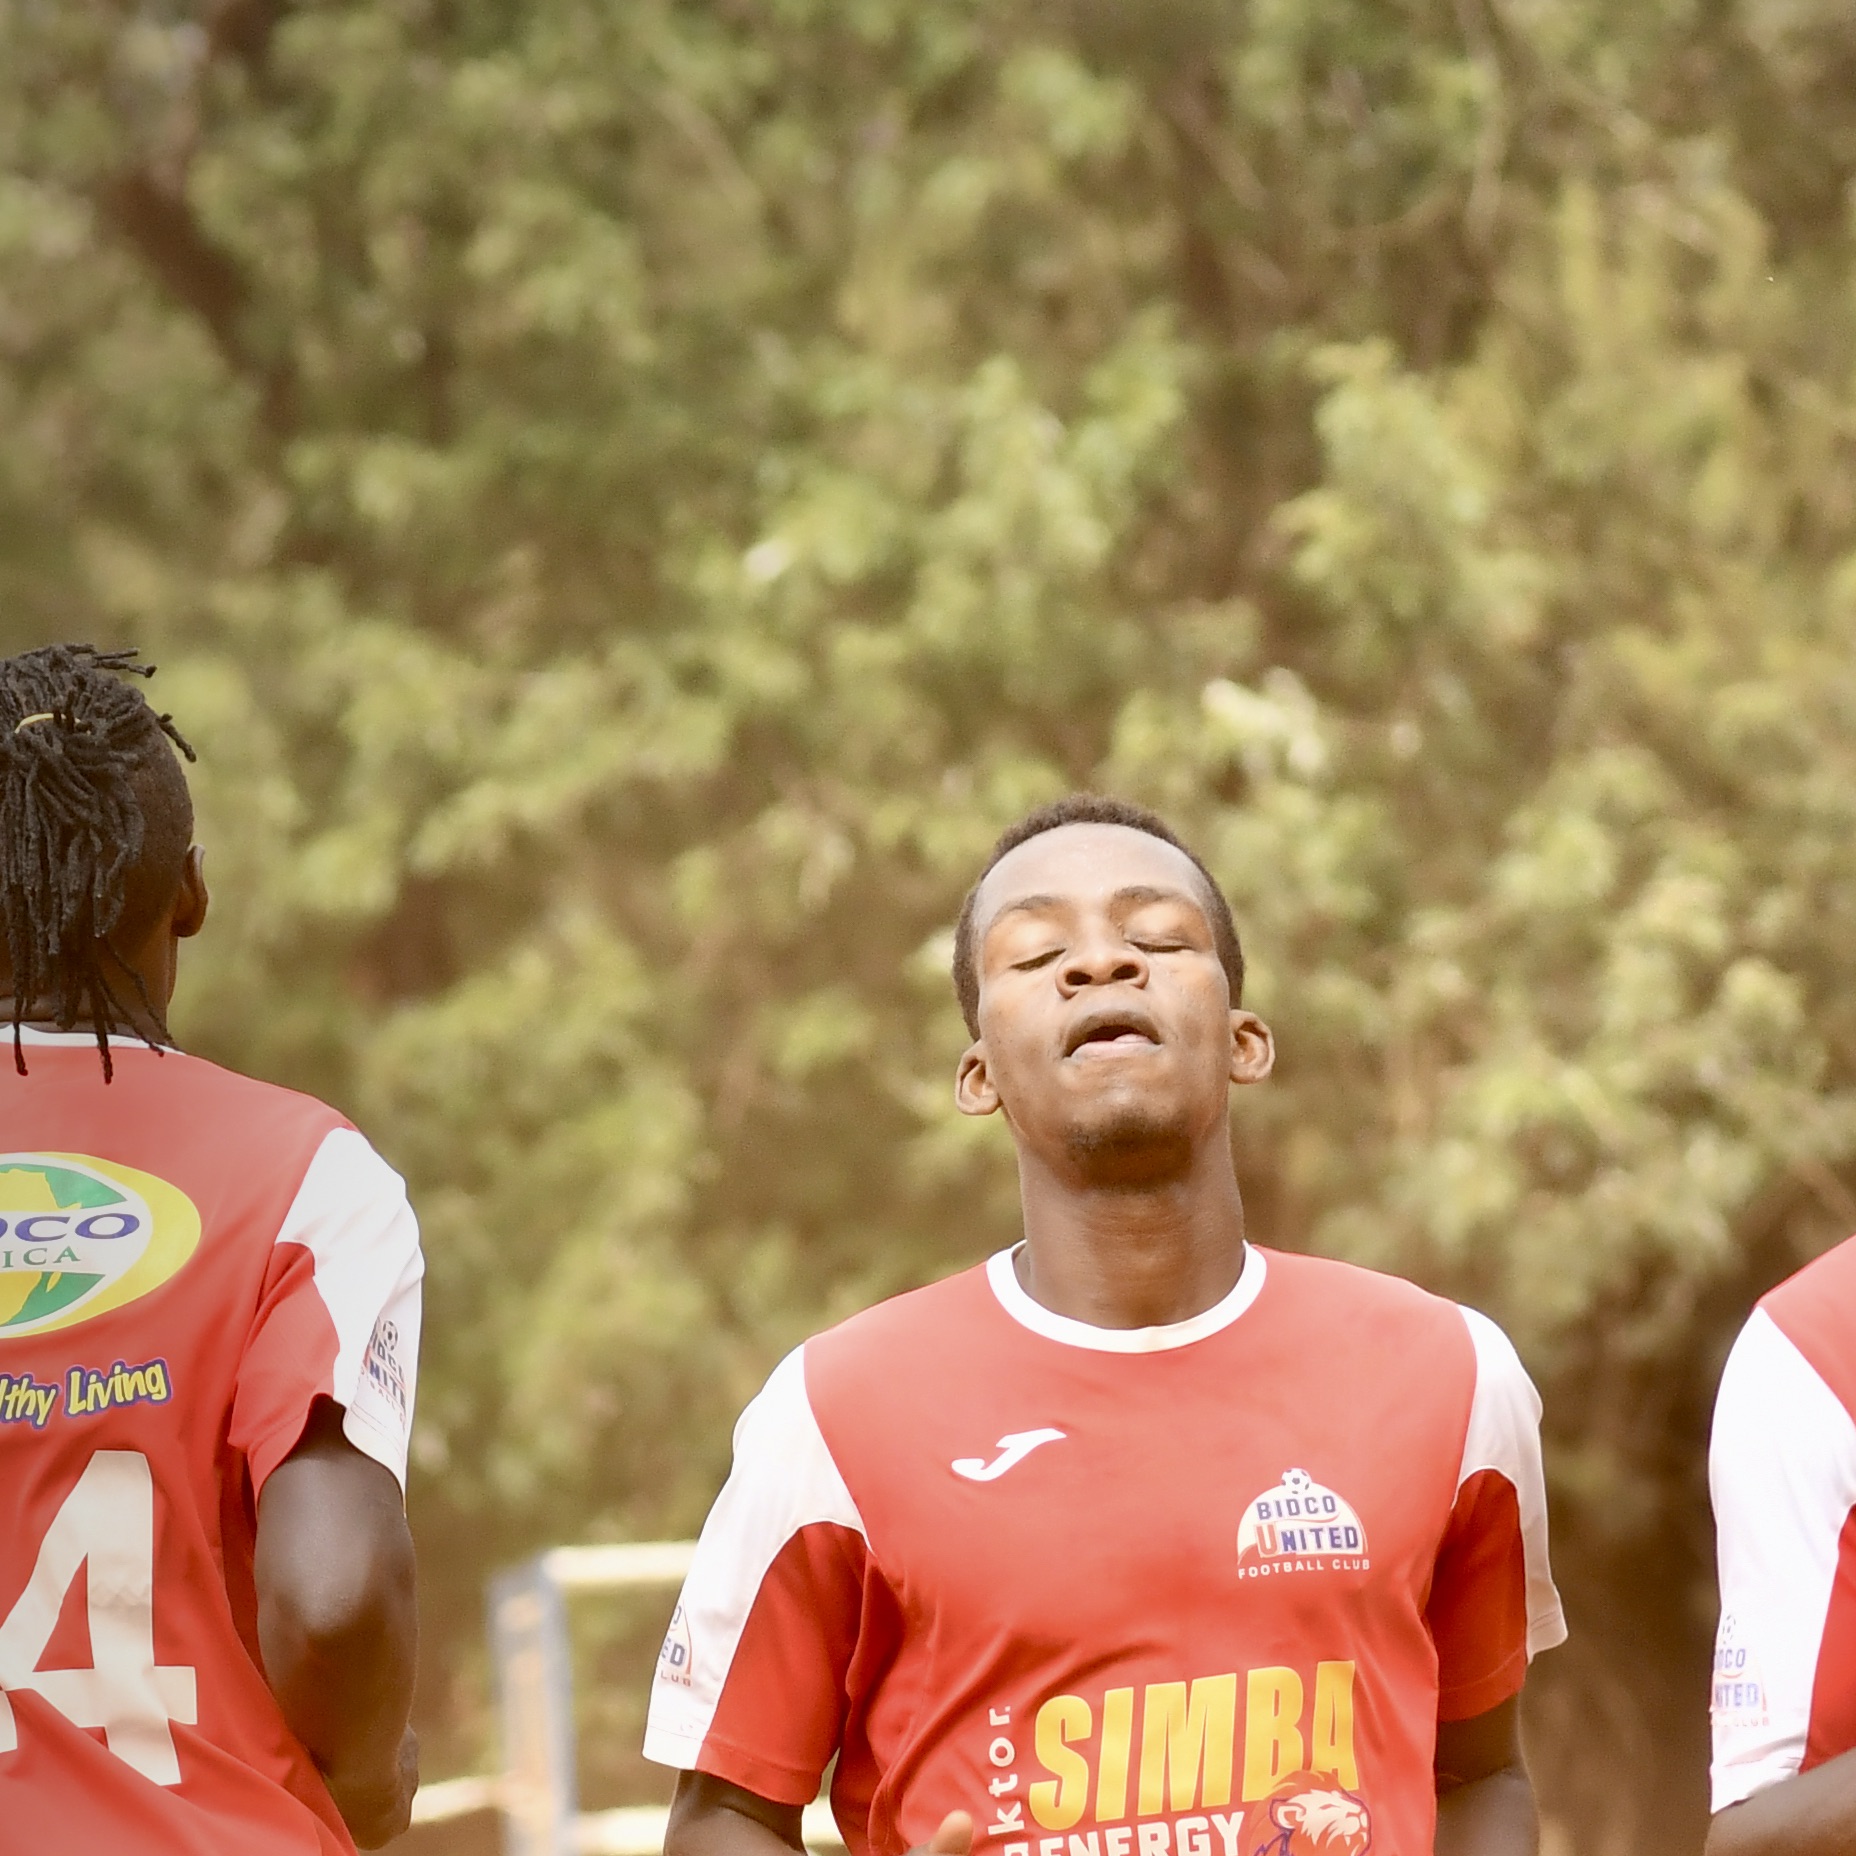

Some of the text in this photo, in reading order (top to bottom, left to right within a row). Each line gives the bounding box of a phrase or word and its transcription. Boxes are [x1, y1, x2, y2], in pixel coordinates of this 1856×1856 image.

[0, 1213, 140, 1242] CO
[68, 1363, 168, 1415] Living
[1256, 1495, 1336, 1520] BIDCO
[1256, 1523, 1359, 1556] UNITED
[1238, 1559, 1370, 1579] FOOTBALL CLUB
[0, 1450, 197, 1785] 4
[1029, 1660, 1360, 1831] SIMBA
